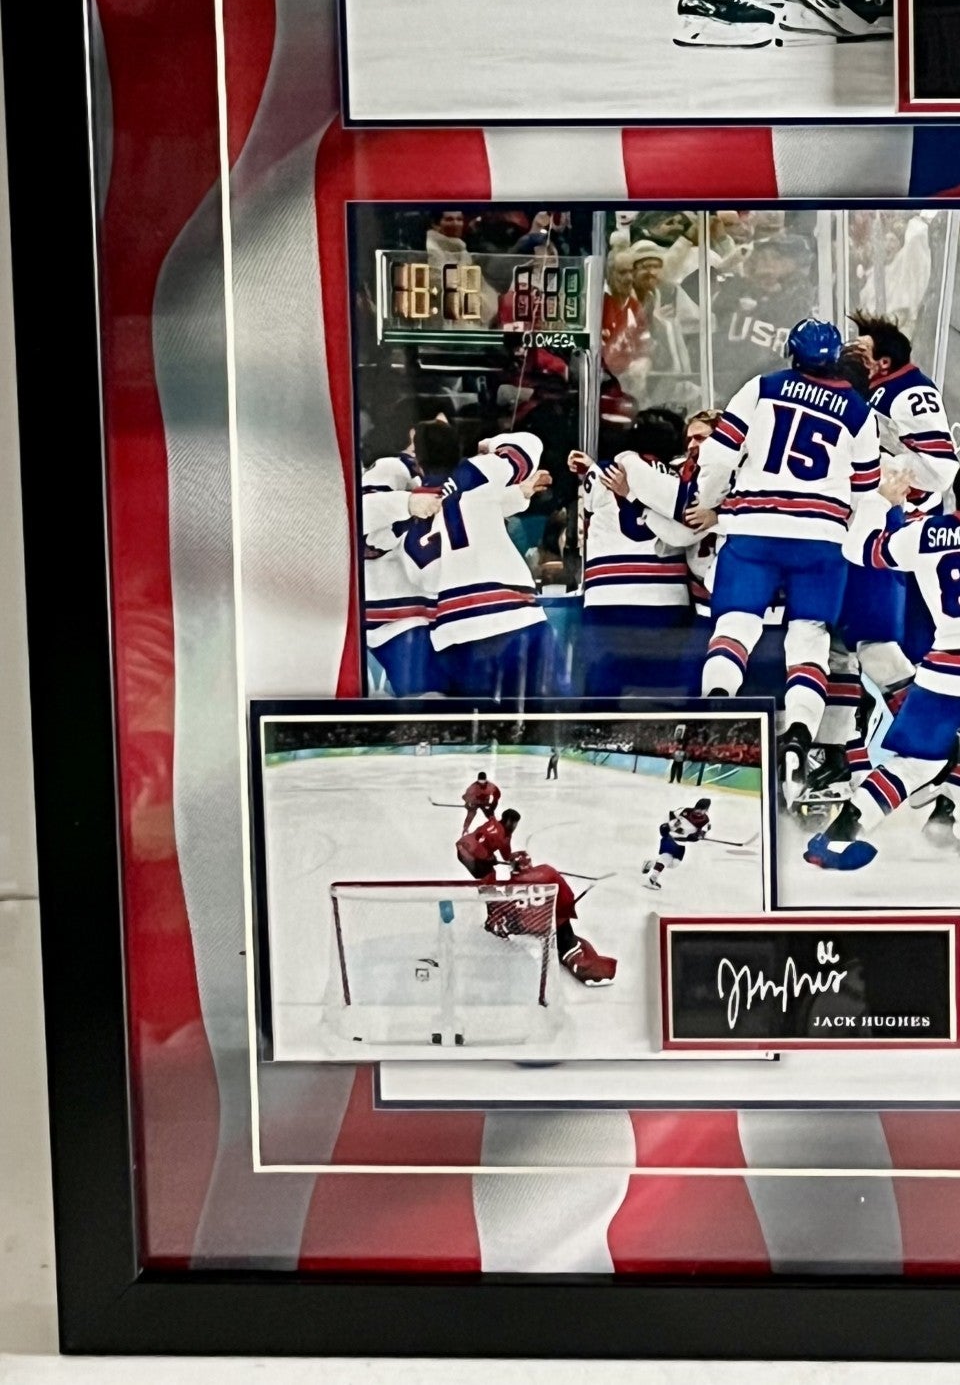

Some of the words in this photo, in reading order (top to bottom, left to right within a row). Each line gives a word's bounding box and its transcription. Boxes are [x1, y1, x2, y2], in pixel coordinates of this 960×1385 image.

[535, 333, 576, 349] OMEGA
[780, 380, 849, 416] HANIFIN
[907, 391, 941, 417] 25
[762, 403, 843, 482] 15
[812, 1015, 857, 1028] JACK
[861, 1015, 931, 1028] HUGHES
